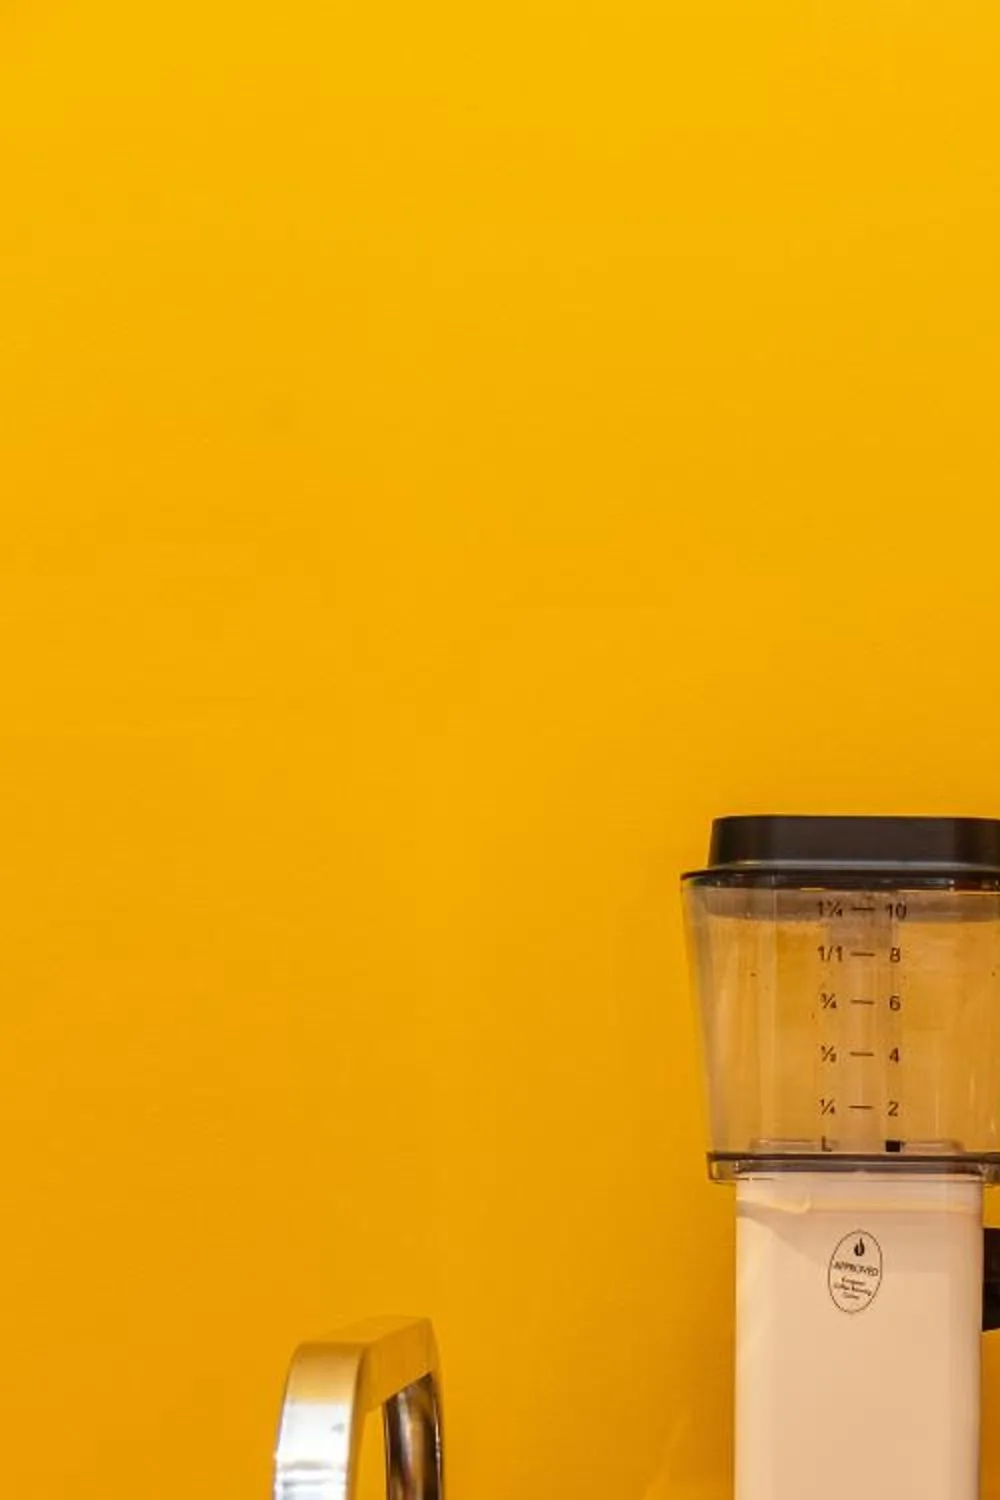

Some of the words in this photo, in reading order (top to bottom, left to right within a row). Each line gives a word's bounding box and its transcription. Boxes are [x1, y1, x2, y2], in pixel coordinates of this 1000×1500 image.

[885, 902, 907, 920] 10
[817, 946, 843, 962] 1/1
[889, 947, 901, 963] 8
[889, 995, 901, 1011] 6
[889, 1047, 899, 1064] 4
[887, 1100, 899, 1117] 2
